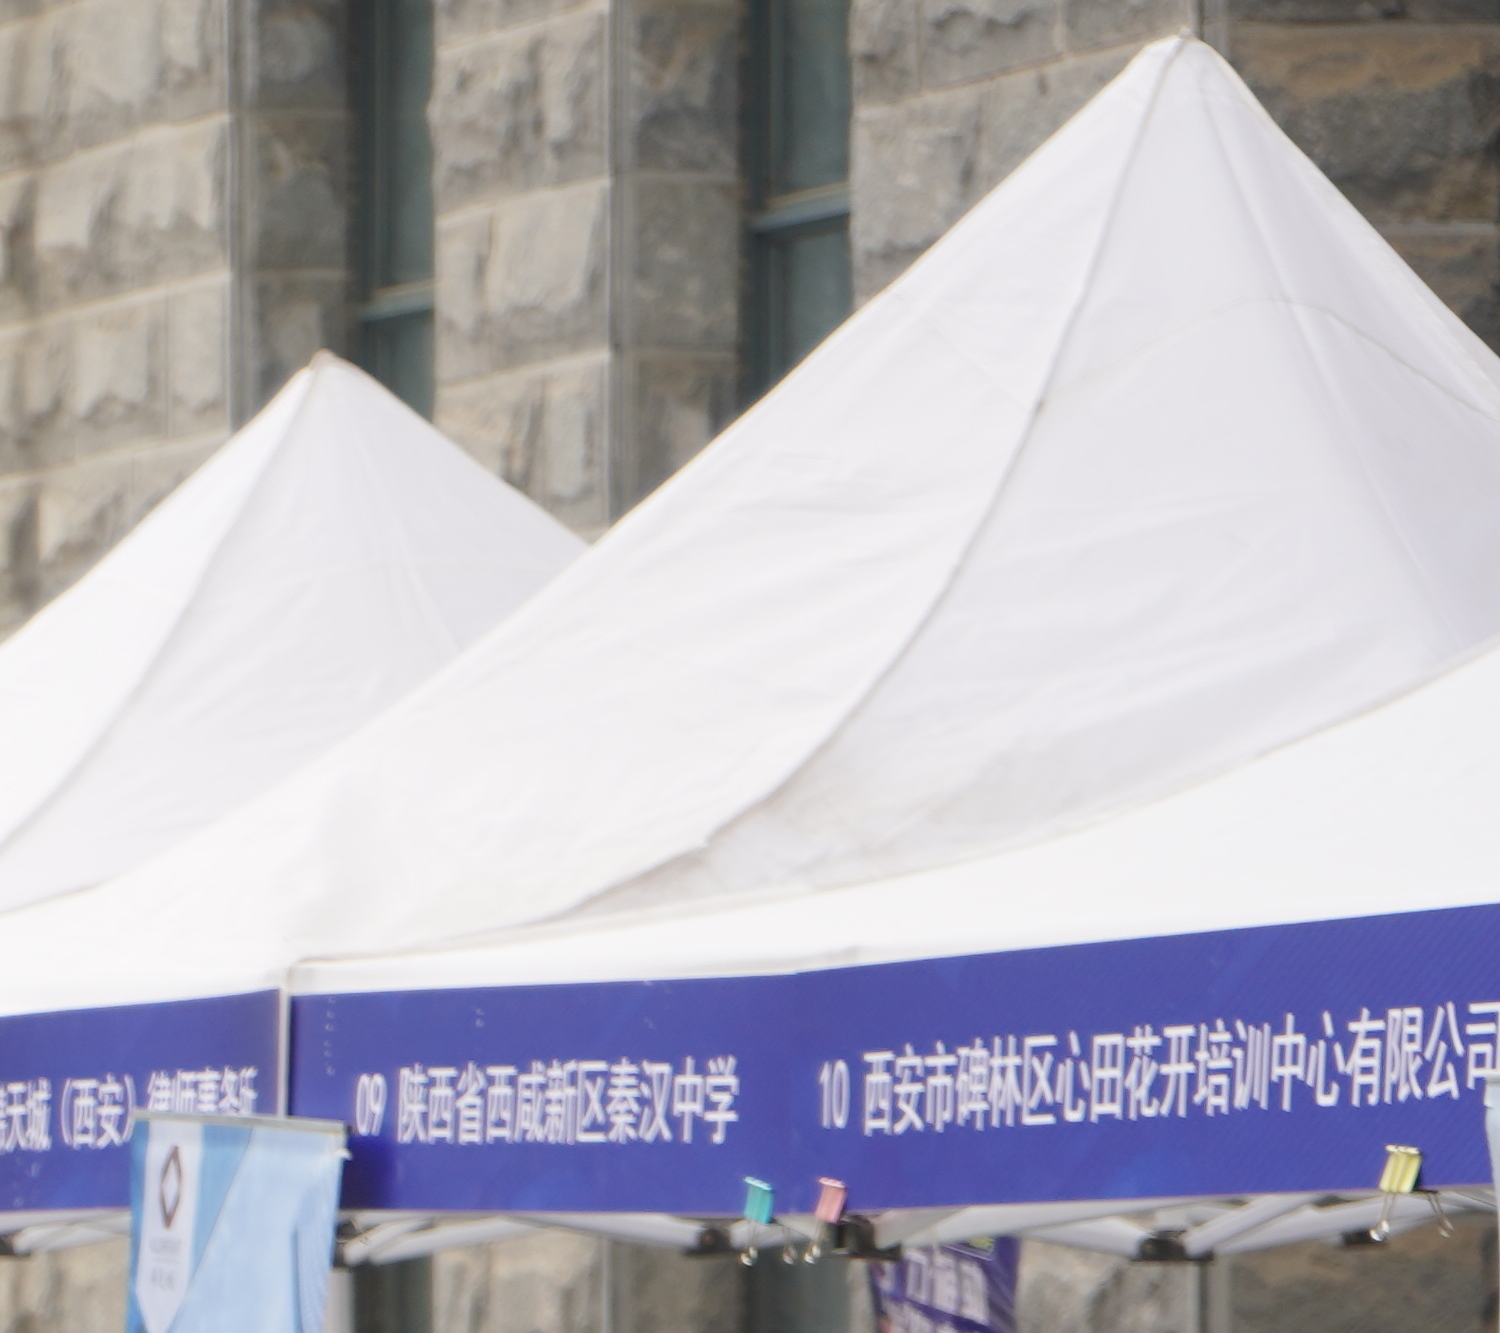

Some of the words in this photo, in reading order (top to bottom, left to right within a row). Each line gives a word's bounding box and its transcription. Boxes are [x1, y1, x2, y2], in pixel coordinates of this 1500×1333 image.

[356, 1072, 387, 1137] 09
[398, 1055, 739, 1146] 陕西省西咸新区秦汉中学
[819, 1058, 850, 1130] 10
[863, 1001, 1500, 1137] 西安市碑林区心田花开培训中心有限公司
